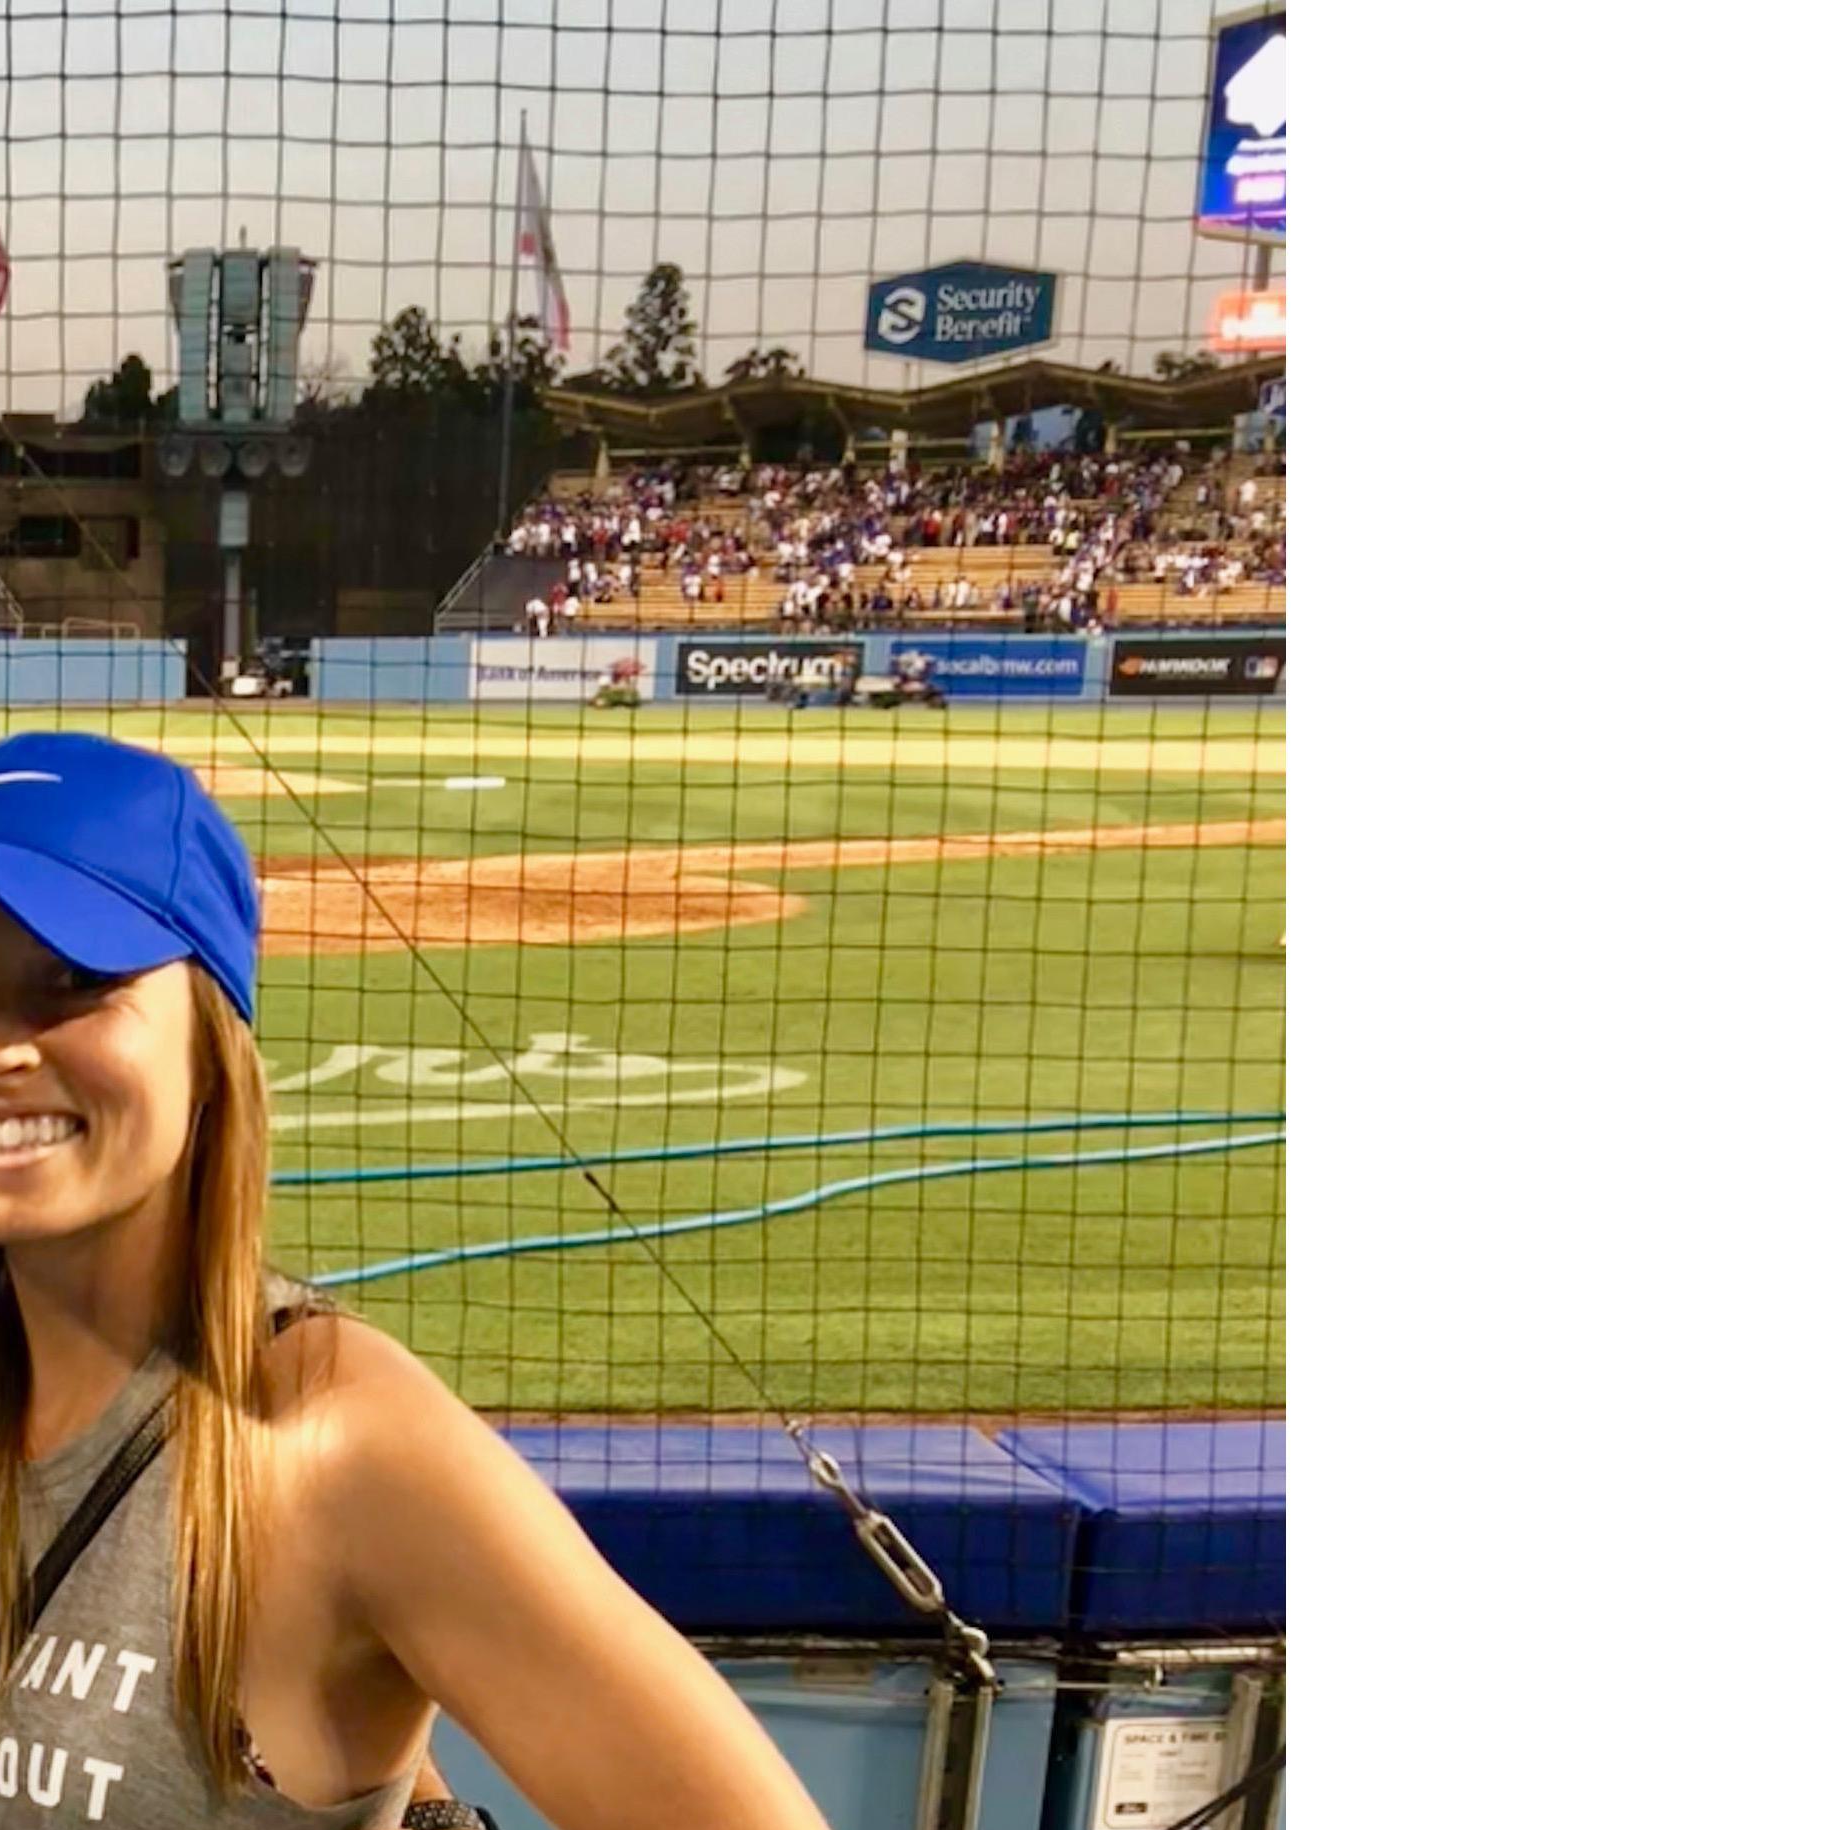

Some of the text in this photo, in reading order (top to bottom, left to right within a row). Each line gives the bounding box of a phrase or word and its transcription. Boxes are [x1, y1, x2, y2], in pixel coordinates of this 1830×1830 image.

[937, 280, 1042, 314] Security
[934, 311, 1021, 342] Benefit
[686, 650, 843, 690] Spectrum
